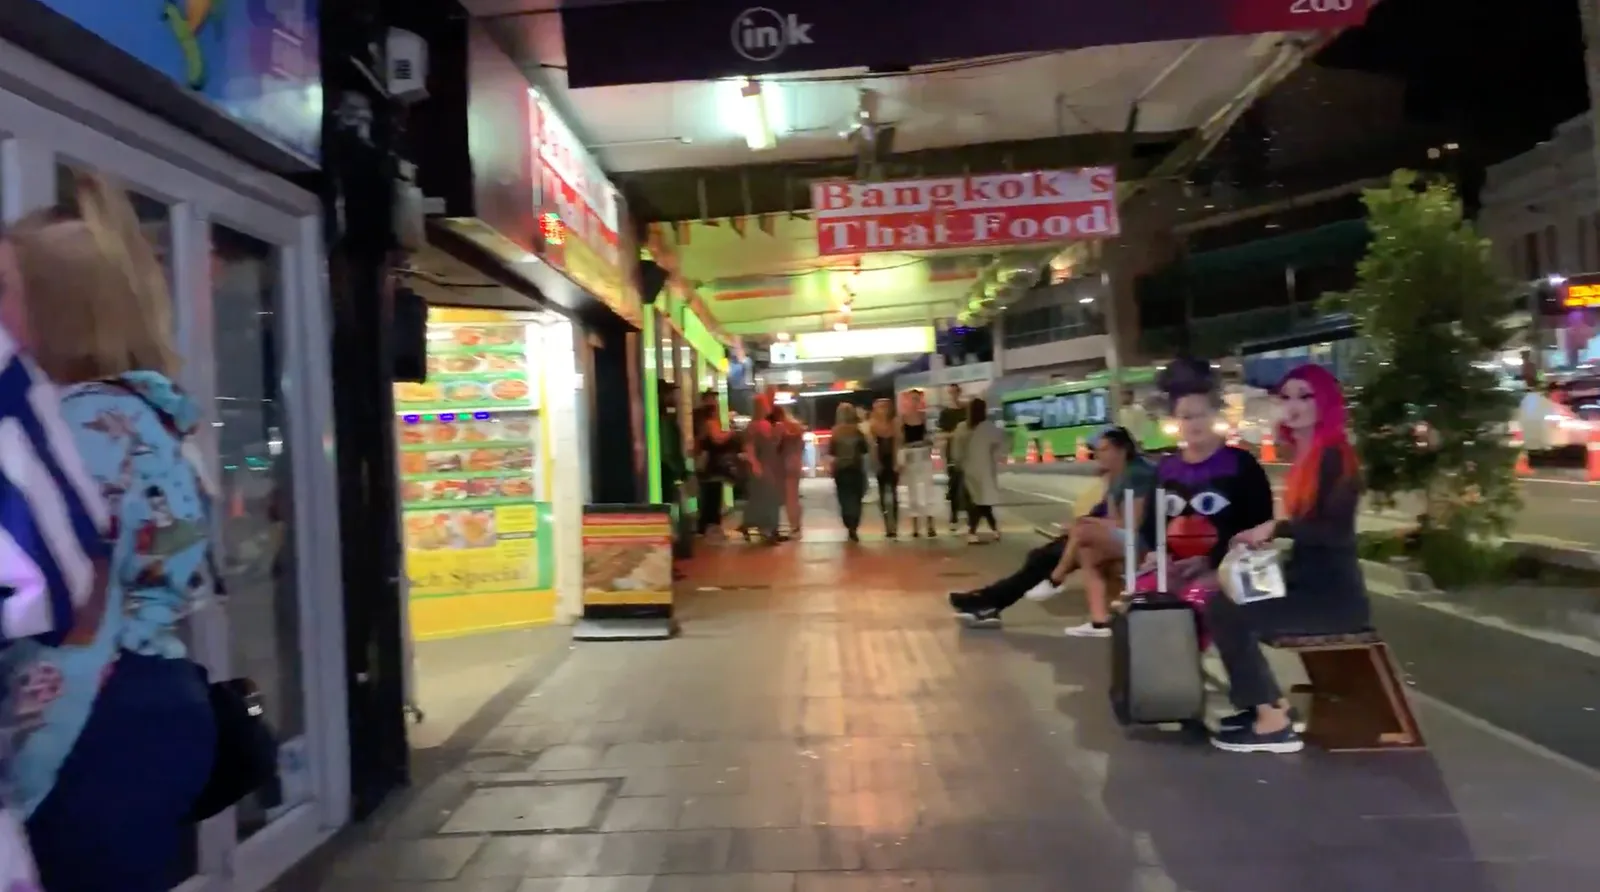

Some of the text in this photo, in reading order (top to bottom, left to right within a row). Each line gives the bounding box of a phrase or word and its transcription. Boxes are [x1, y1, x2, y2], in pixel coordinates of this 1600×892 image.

[743, 13, 815, 48] ink
[821, 204, 1110, 250] Thai Food
